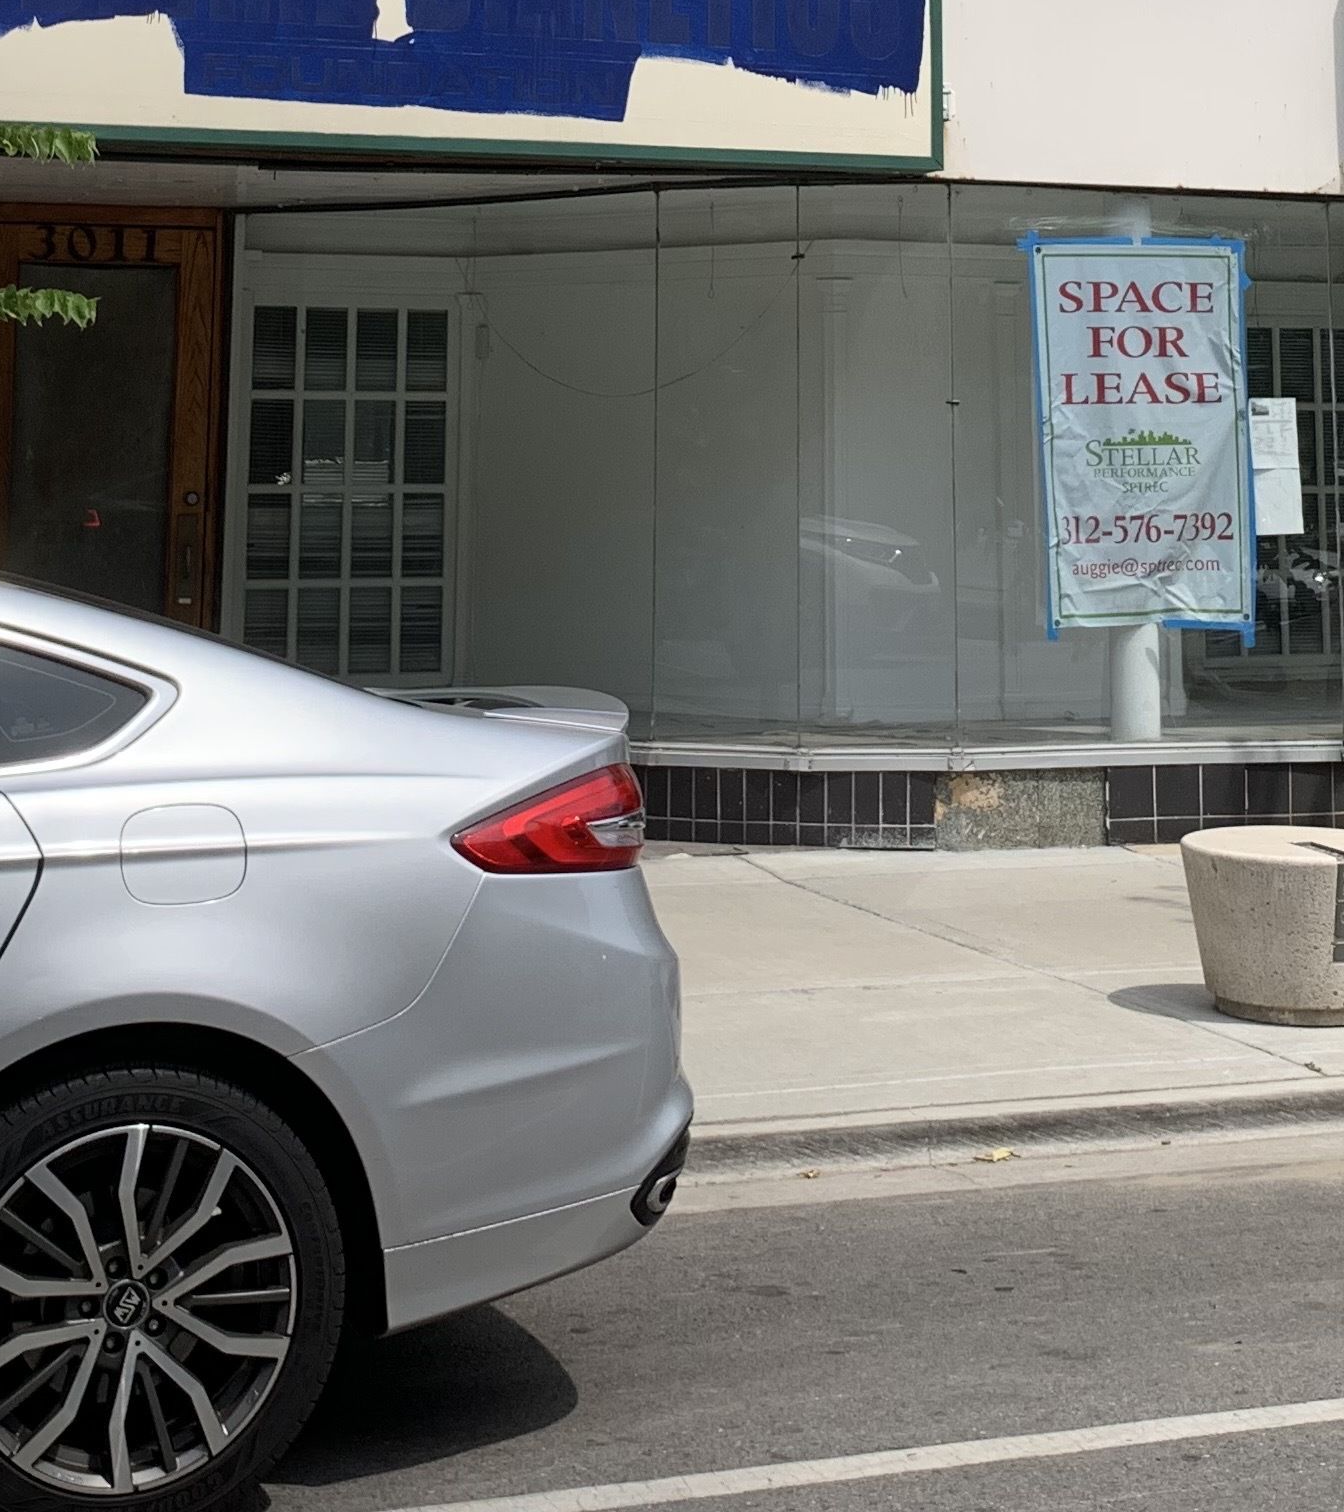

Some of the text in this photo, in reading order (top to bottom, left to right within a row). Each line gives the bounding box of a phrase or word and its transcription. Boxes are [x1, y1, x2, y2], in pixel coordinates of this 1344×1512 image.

[200, 52, 623, 105] FOUNDATION
[29, 225, 157, 262] 3011
[1058, 280, 1214, 314] SPACE
[1085, 325, 1190, 359] FOR
[1060, 371, 1223, 406] LEASE
[1084, 439, 1202, 468] STELLAR
[1093, 466, 1197, 479] PERFORMANCE
[1060, 511, 1235, 546] 312-576-7392
[1072, 556, 1221, 579] auggie@sptrec.com
